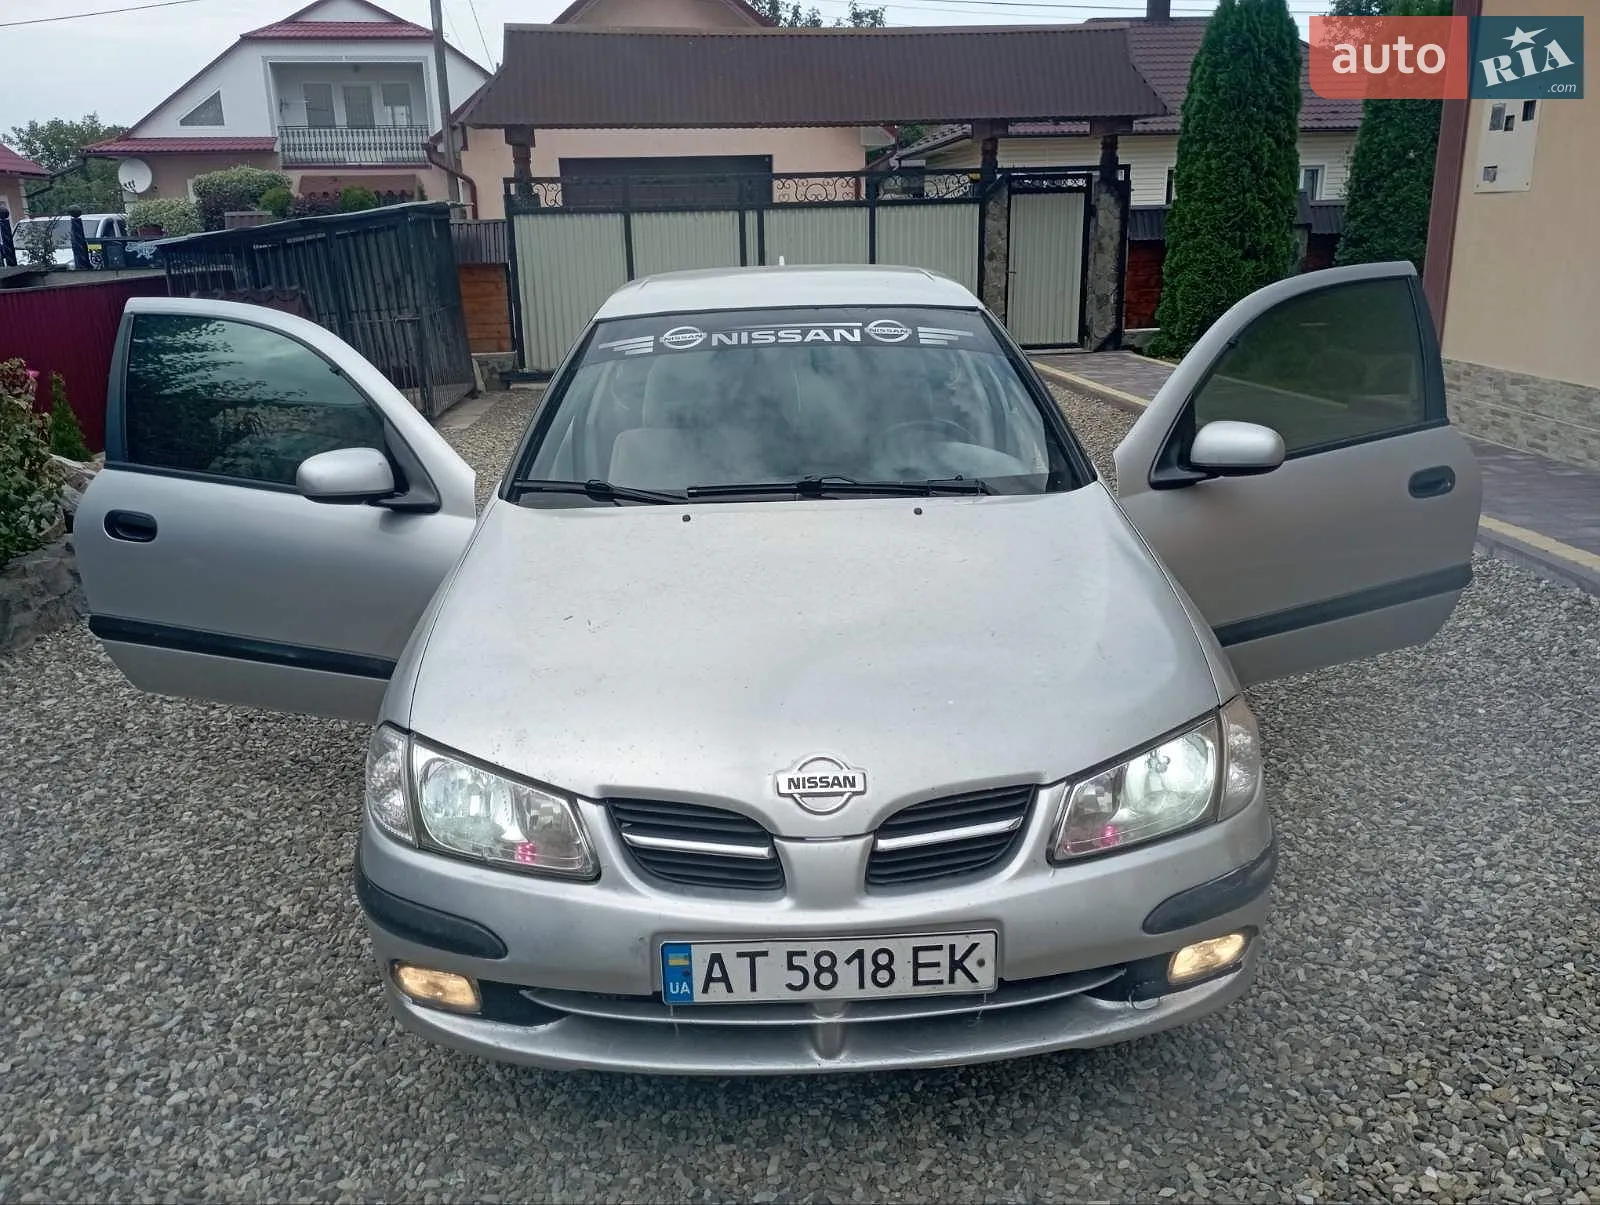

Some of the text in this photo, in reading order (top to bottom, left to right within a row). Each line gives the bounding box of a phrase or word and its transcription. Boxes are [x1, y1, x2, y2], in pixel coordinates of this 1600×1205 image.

[662, 332, 705, 342] NISSAN
[711, 328, 861, 346] NISSAN
[868, 327, 910, 336] NISSAN
[787, 775, 856, 790] NISSAN
[701, 942, 980, 994] AT 5818 EK
[669, 982, 691, 995] UA
